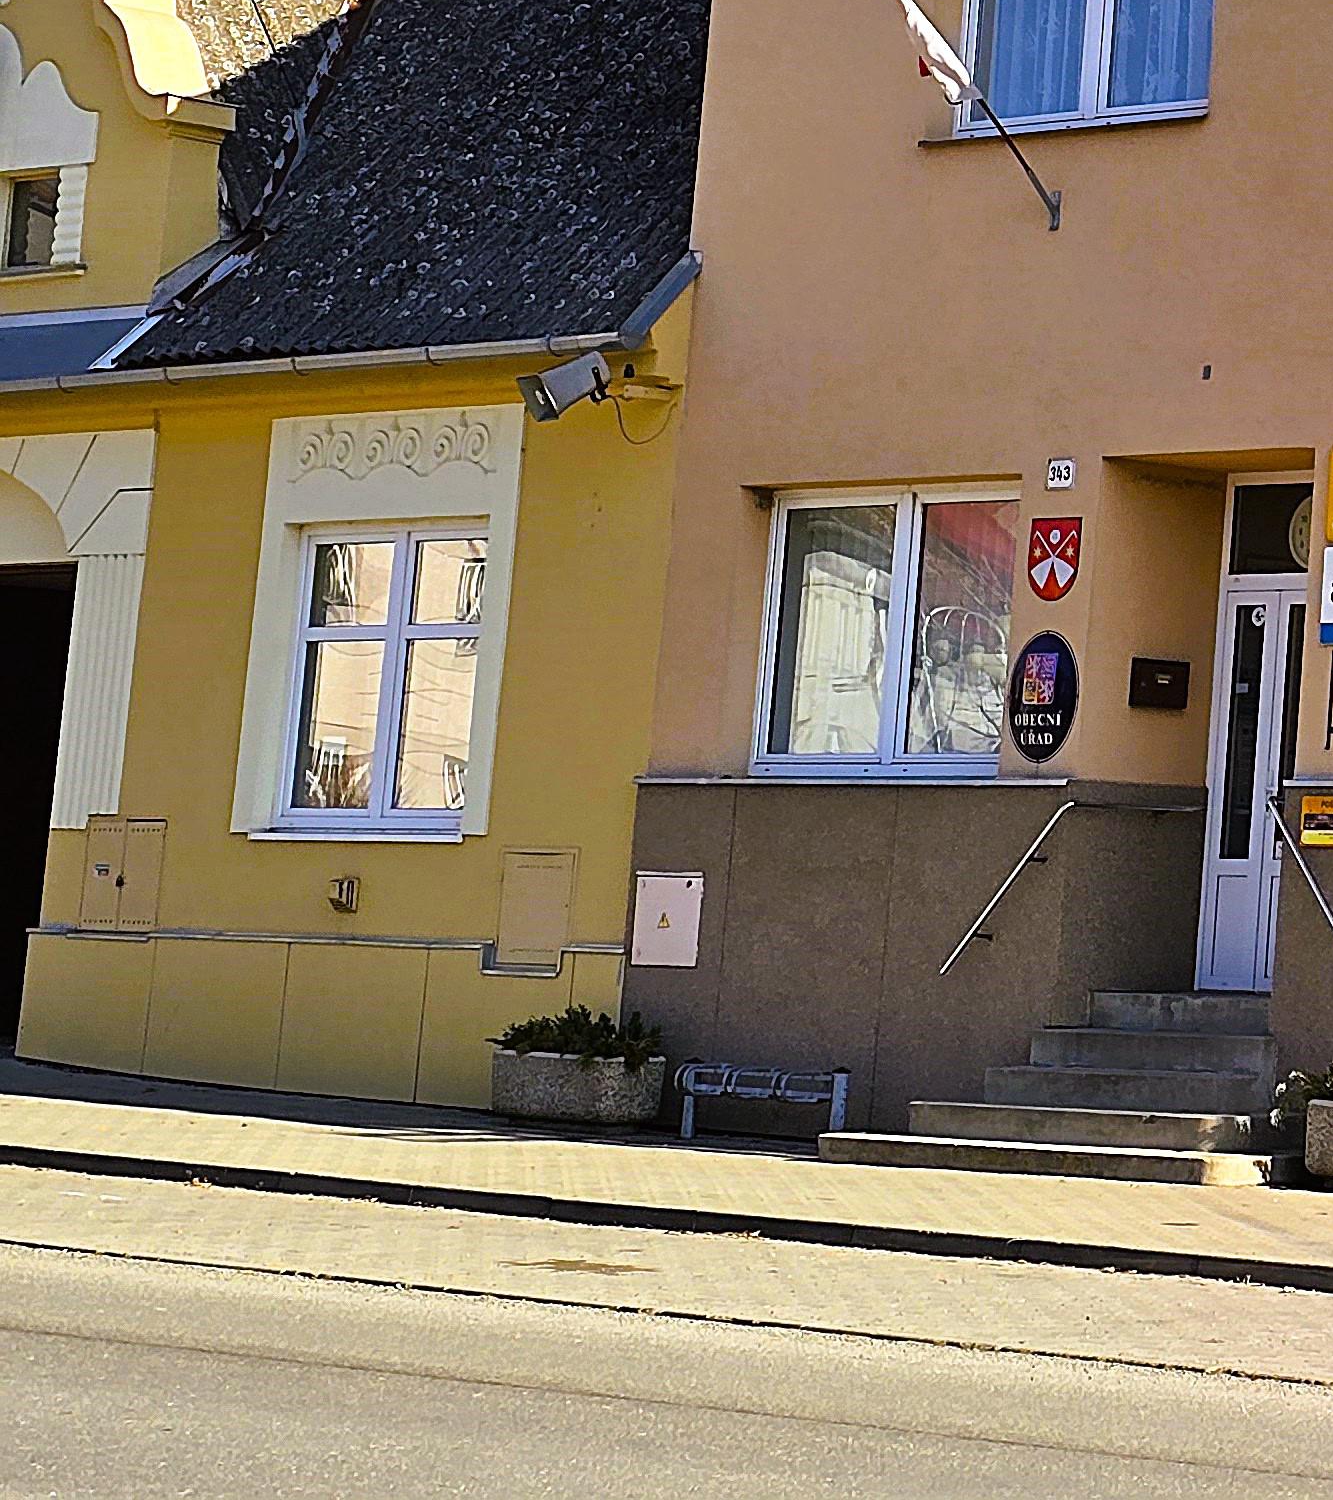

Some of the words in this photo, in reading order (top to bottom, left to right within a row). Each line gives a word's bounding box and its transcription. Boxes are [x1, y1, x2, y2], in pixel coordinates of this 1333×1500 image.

[1049, 465, 1071, 481] 343
[1014, 710, 1063, 727] OBECNÍ
[1020, 729, 1053, 746] ÚŘAD
